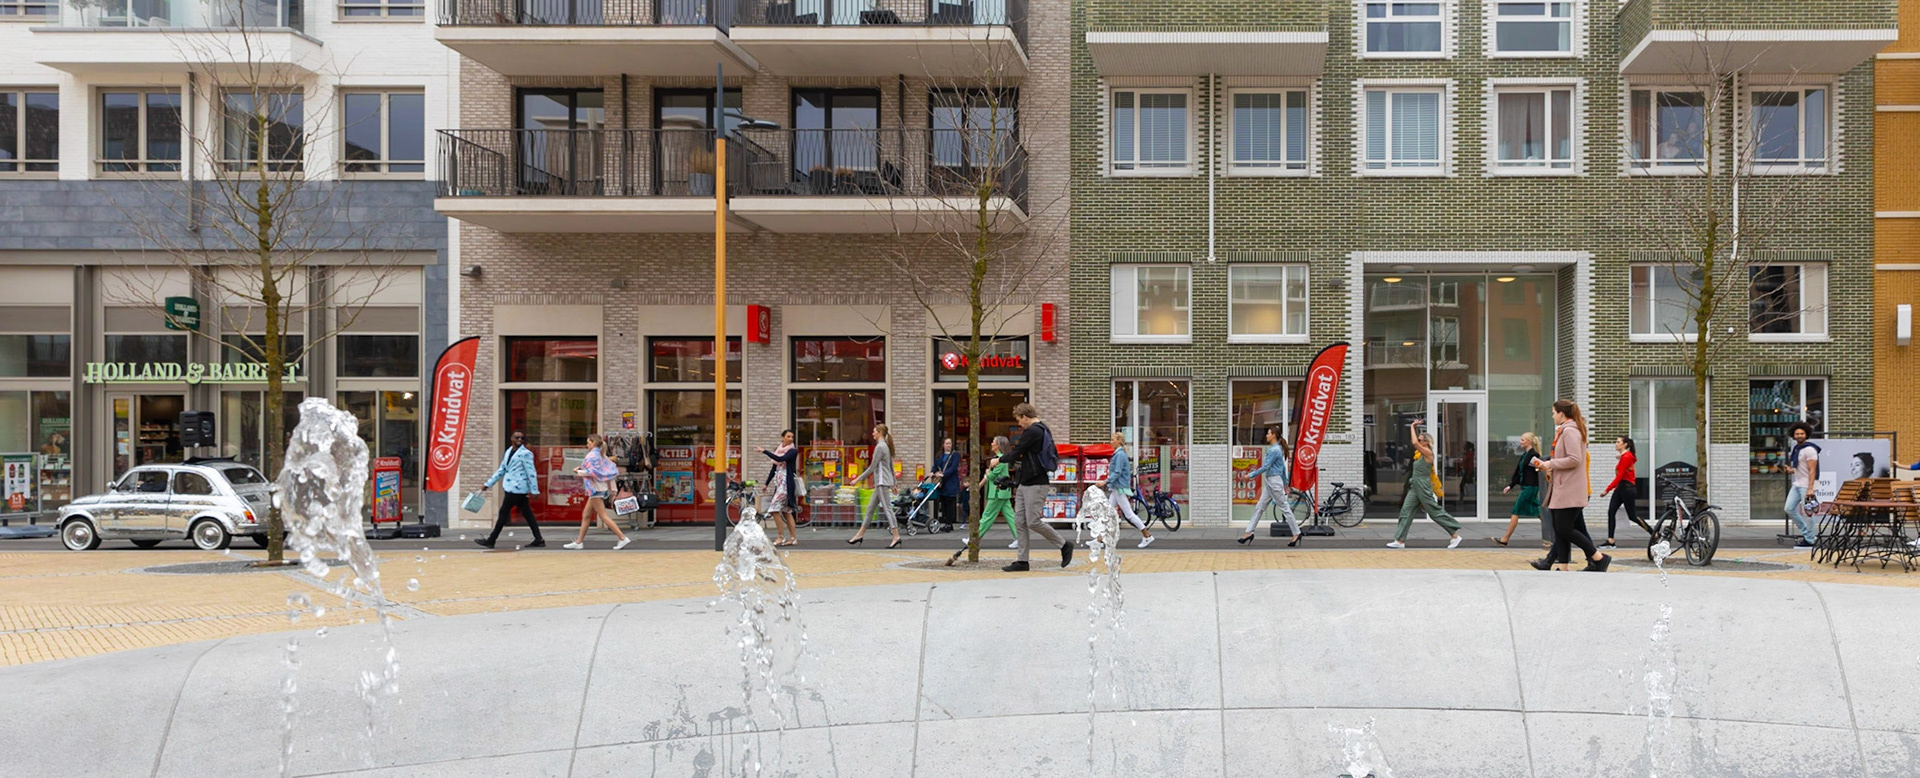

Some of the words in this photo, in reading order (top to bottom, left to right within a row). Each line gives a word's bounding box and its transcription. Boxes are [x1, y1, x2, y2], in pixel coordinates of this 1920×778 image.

[87, 362, 182, 384] HOLLAND
[185, 363, 205, 384] &
[209, 362, 300, 384] BARRET
[437, 371, 466, 444] Kruidvat
[1303, 373, 1333, 445] Kruidvat
[659, 449, 689, 458] ACTIE!
[809, 450, 839, 458] ACTIE!
